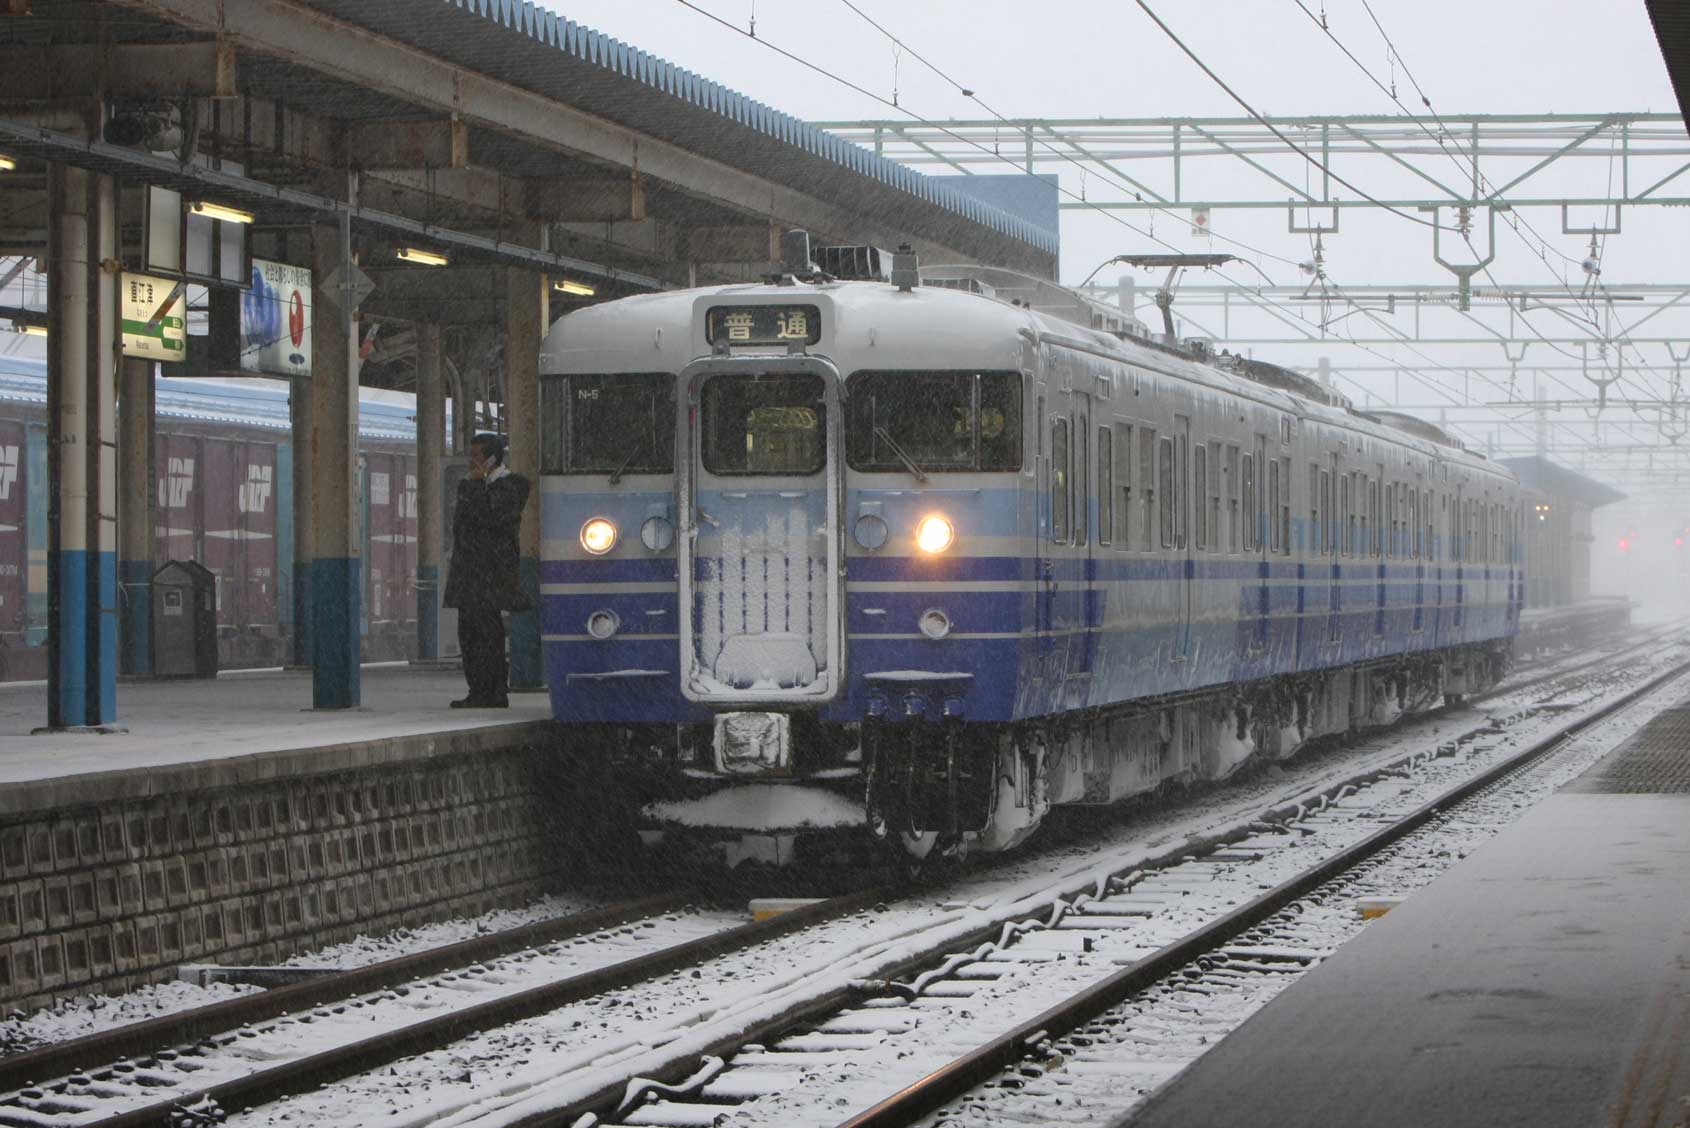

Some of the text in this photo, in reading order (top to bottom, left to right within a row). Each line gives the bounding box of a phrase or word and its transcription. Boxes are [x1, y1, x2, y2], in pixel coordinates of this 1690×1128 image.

[724, 311, 809, 340] 普通
[158, 457, 195, 508] JRF
[238, 464, 273, 513] JRF
[398, 474, 418, 518] JR
